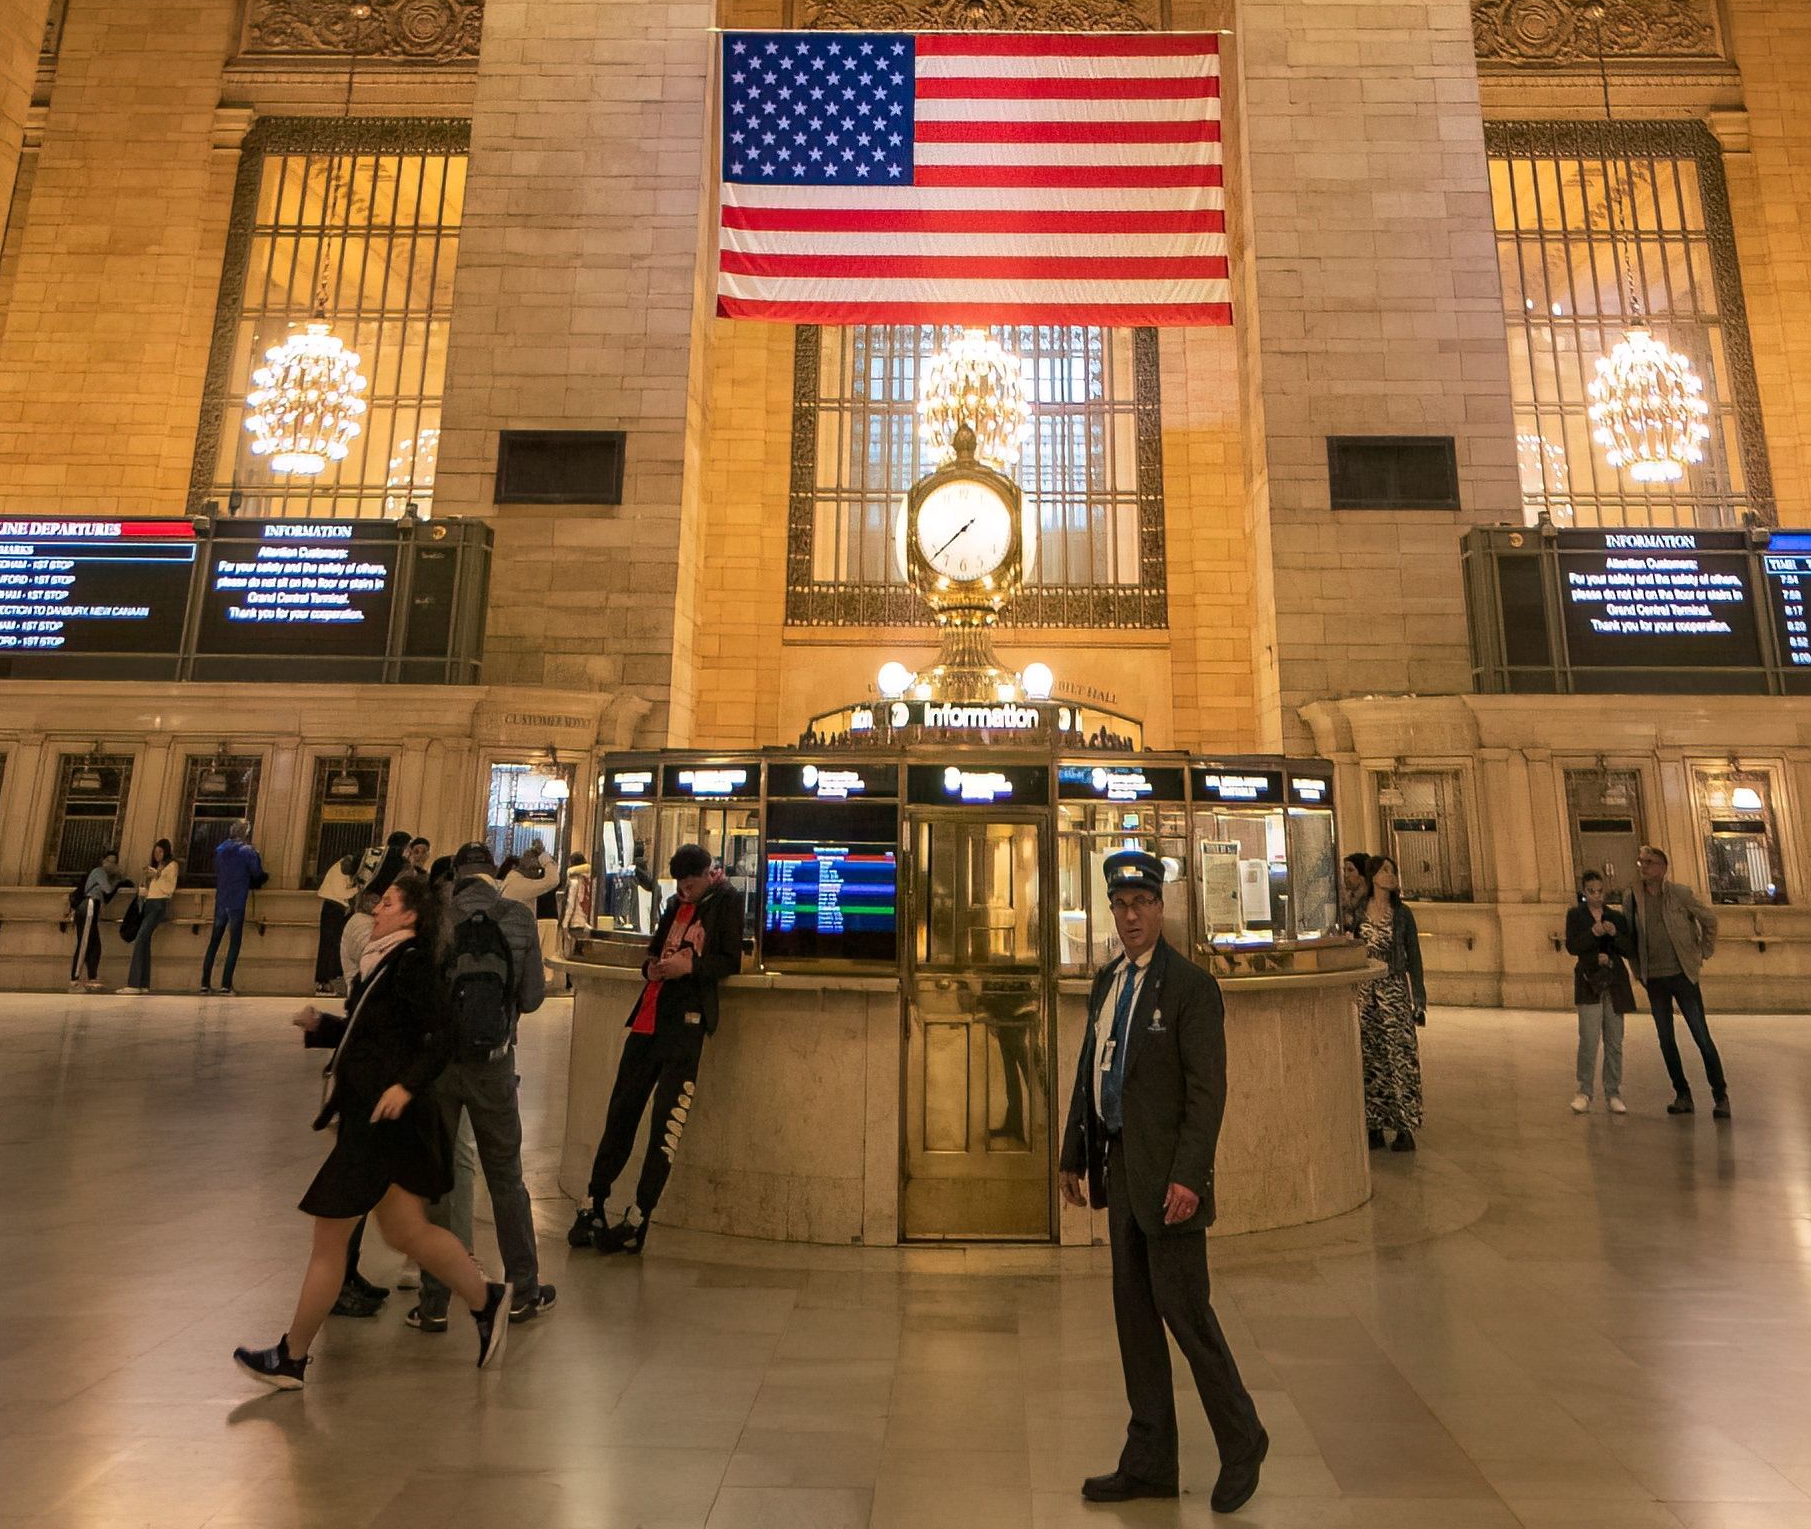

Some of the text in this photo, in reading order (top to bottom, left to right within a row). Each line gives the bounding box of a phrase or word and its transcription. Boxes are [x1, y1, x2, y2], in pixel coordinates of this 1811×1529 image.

[29, 522, 122, 536] DEPARTURES
[265, 525, 352, 537] INFORMATION
[1606, 535, 1695, 547] INFORMATION
[258, 546, 297, 557] Attention
[218, 560, 234, 571] For
[235, 562, 255, 574] your
[256, 561, 283, 574] safety
[283, 562, 301, 572] and
[303, 562, 317, 572] the
[317, 562, 345, 575] safety
[345, 562, 355, 573] of
[959, 558, 968, 572] 6
[1605, 557, 1645, 569] Attention
[216, 576, 247, 589] please
[247, 577, 259, 587] do
[261, 578, 275, 588] not
[288, 579, 300, 588] on
[302, 578, 316, 588] the
[317, 578, 337, 588] floor
[374, 579, 384, 589] in
[1569, 572, 1585, 584] For
[1586, 574, 1606, 586] your
[1635, 573, 1654, 584] and
[1655, 573, 1670, 584] the
[1698, 573, 1709, 584] of
[247, 592, 276, 603] Grand
[277, 592, 309, 603] Central
[1602, 589, 1615, 599] do
[1617, 589, 1631, 599] not
[1645, 590, 1657, 599] on
[1658, 589, 1673, 599] the
[1733, 589, 1742, 600] in
[228, 606, 256, 618] Thank
[256, 609, 275, 621] you
[275, 608, 289, 619] for
[289, 610, 309, 621] your
[1606, 603, 1635, 615] Grand
[1636, 604, 1670, 615] Central
[1591, 619, 1620, 630] Thank
[1620, 621, 1639, 633] you
[1639, 620, 1652, 630] for
[1654, 621, 1674, 633] your
[924, 701, 1039, 728] Information
